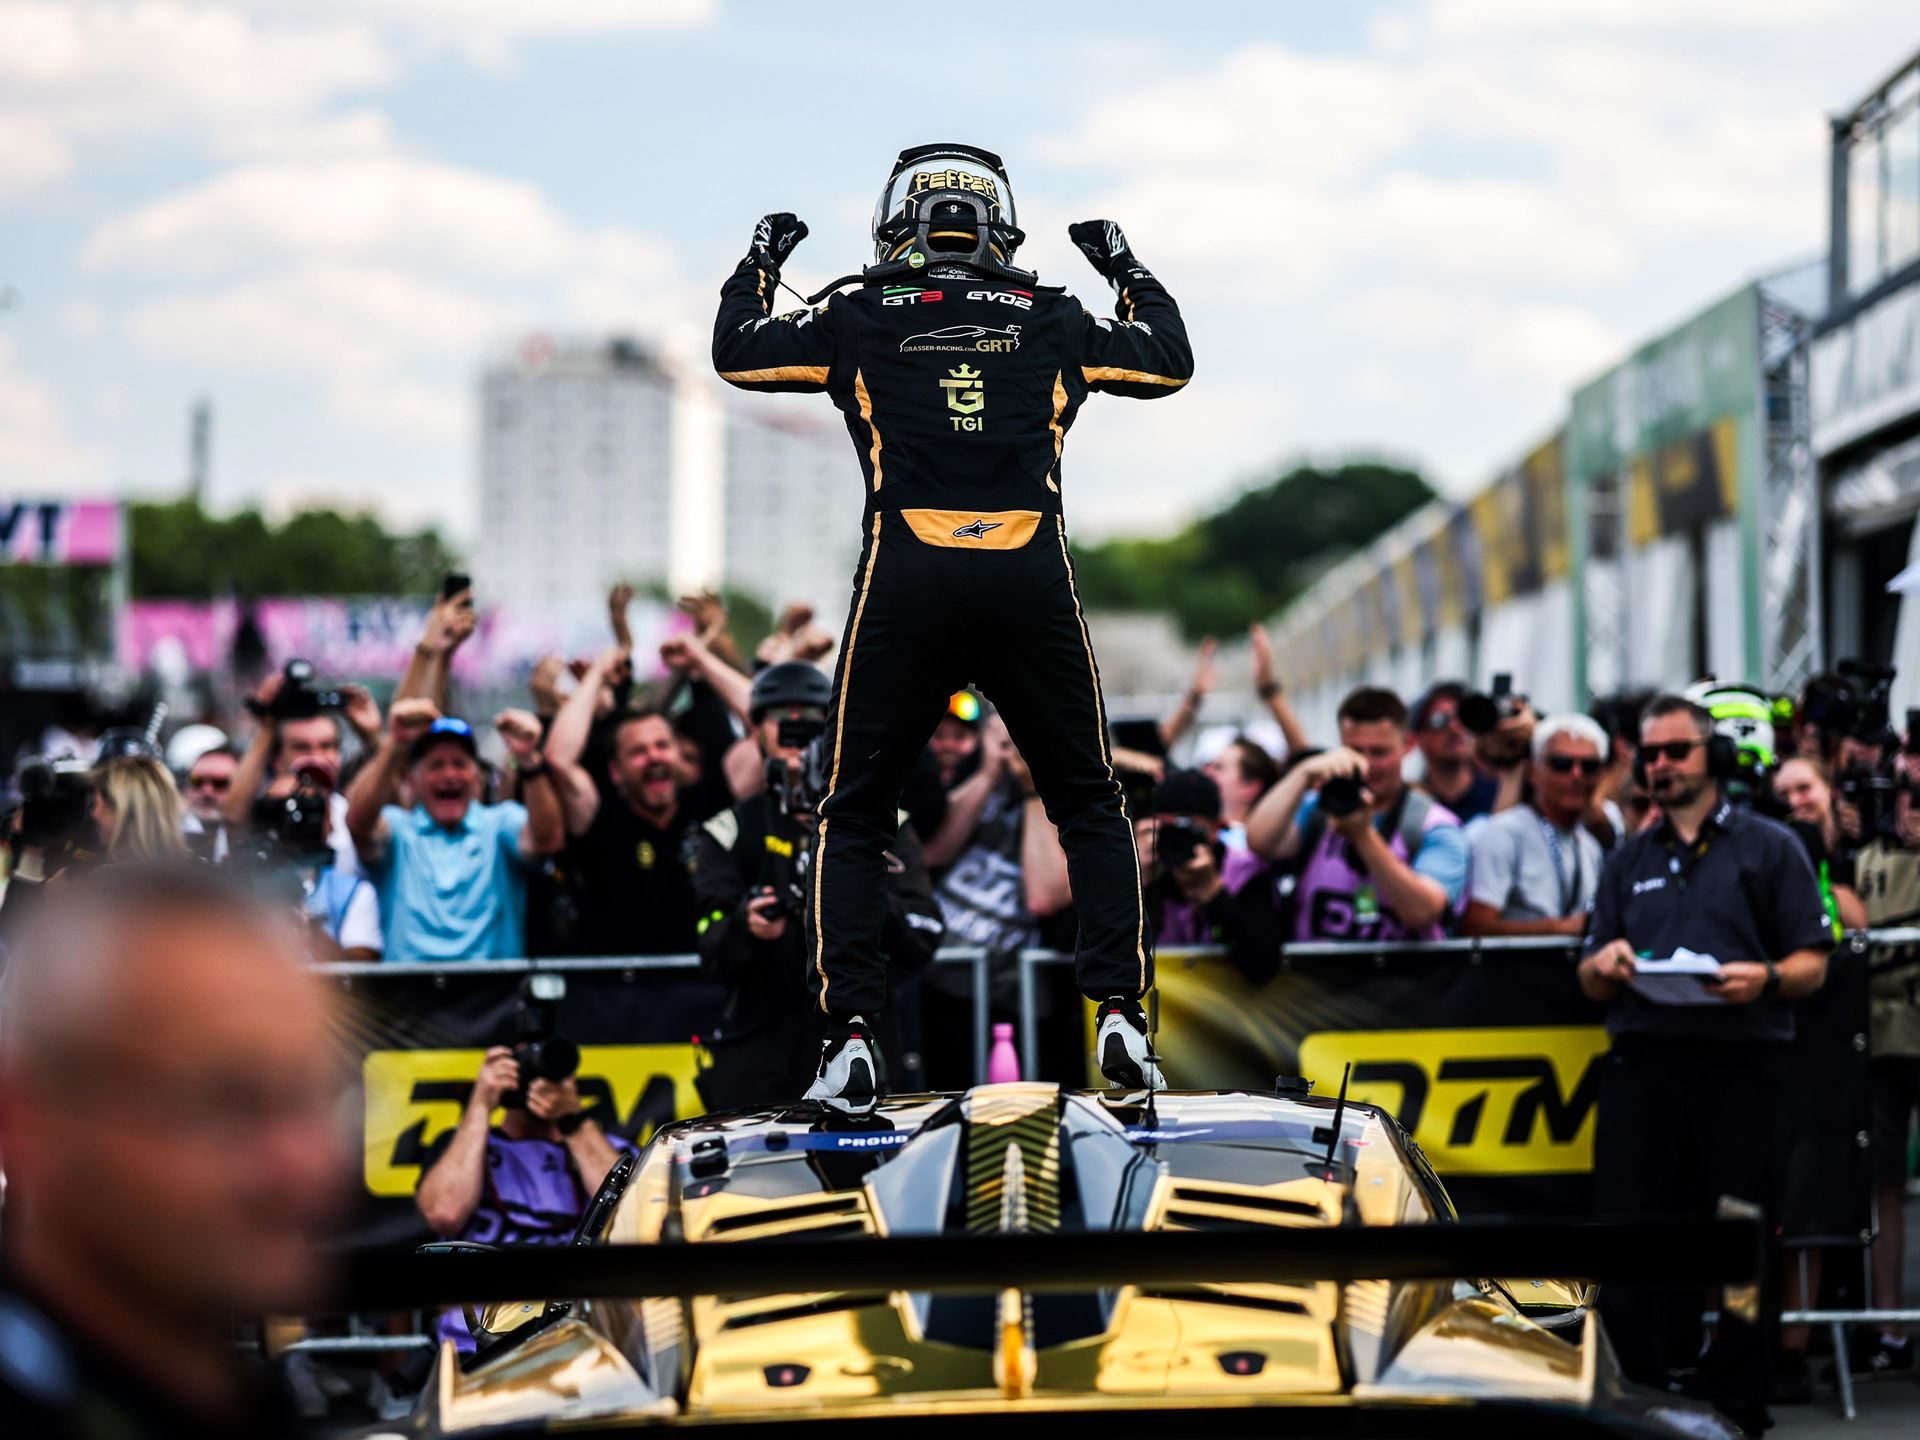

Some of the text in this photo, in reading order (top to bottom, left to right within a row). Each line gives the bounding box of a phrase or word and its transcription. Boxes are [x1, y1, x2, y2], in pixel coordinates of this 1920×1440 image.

[882, 290, 1034, 311] GT3 EVO2
[975, 339, 1014, 353] GRT
[950, 416, 983, 432] TGI
[837, 1135, 909, 1147] PROUD
